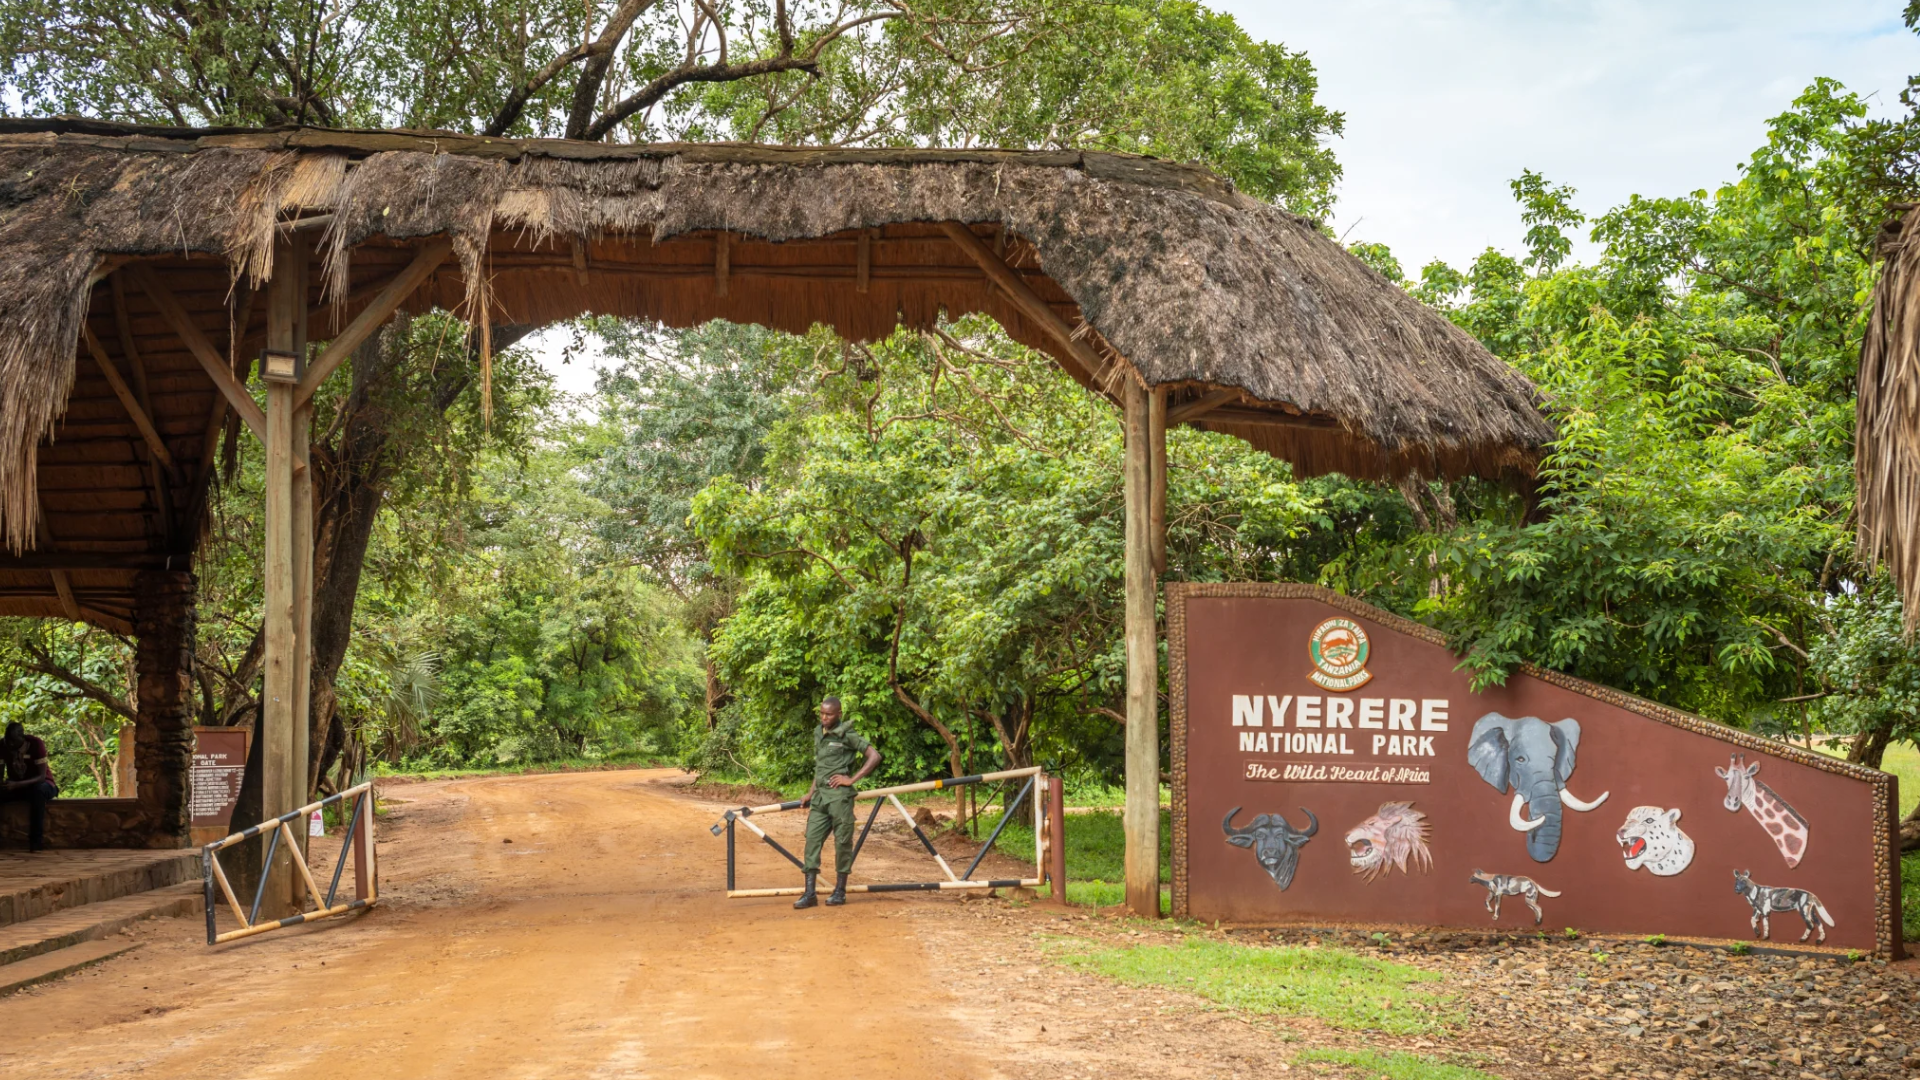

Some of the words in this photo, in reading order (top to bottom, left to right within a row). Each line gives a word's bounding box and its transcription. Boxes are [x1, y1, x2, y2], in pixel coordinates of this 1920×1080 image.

[1339, 619, 1349, 628] ZA
[1349, 623, 1367, 644] TAIFA
[1317, 659, 1362, 675] TANZANIA
[1311, 671, 1350, 688] NATIONAL
[1349, 670, 1370, 686] PARKS
[1232, 695, 1449, 732] NYERERE
[1239, 731, 1354, 755] NATIONAL
[1372, 734, 1436, 756] PARK
[1246, 763, 1281, 779] The
[1283, 764, 1328, 780] Wild
[1330, 765, 1380, 781] Heart
[1381, 767, 1397, 783] of
[1395, 767, 1430, 783] Africa
